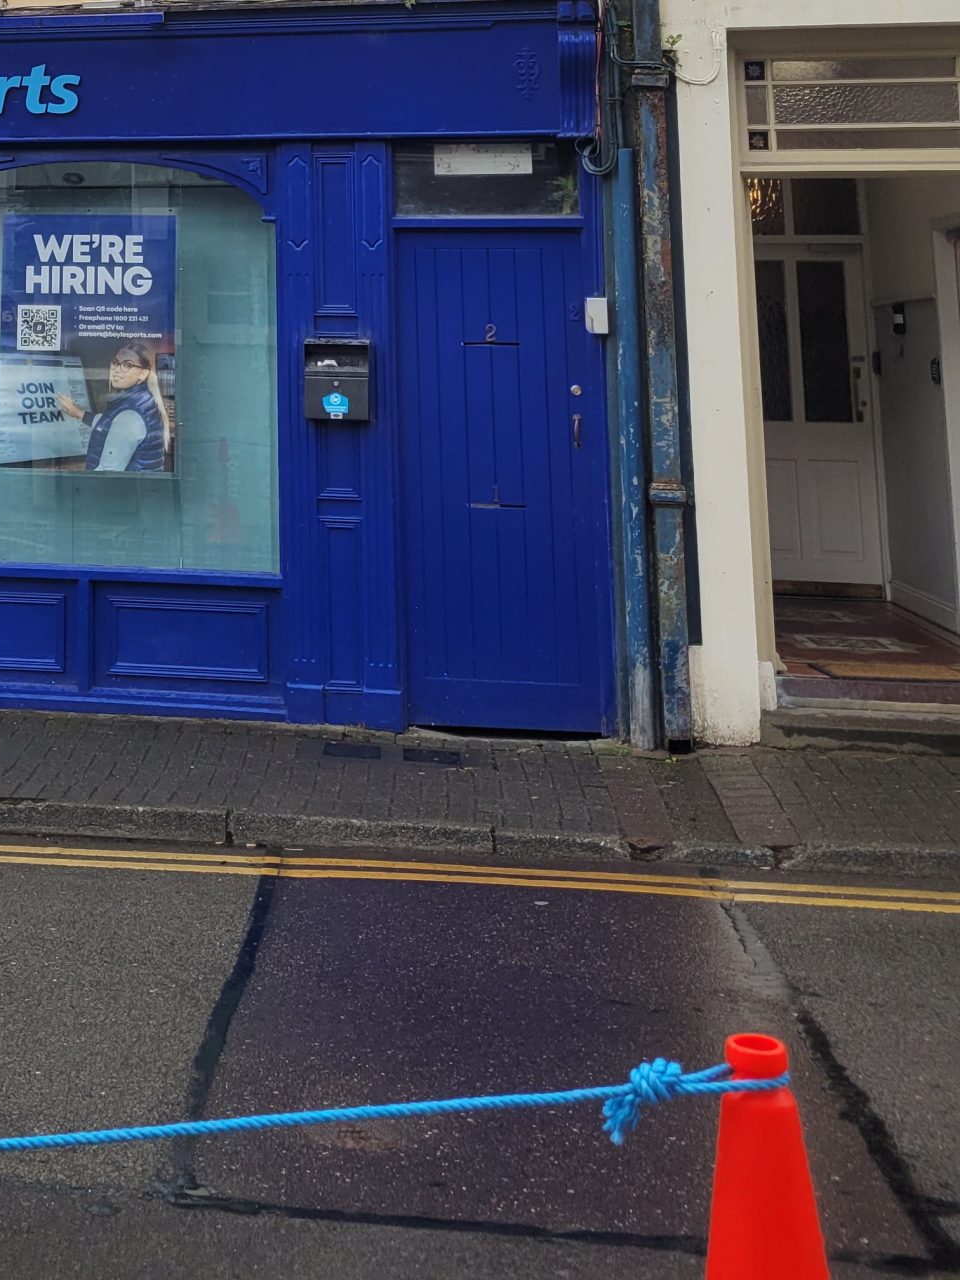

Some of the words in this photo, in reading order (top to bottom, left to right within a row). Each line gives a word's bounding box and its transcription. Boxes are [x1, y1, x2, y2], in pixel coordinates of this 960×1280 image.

[25, 265, 153, 296] HIRING
[486, 324, 497, 341] 2
[16, 382, 55, 395] JOIN
[21, 396, 57, 410] OUR
[18, 410, 65, 425] TEAM
